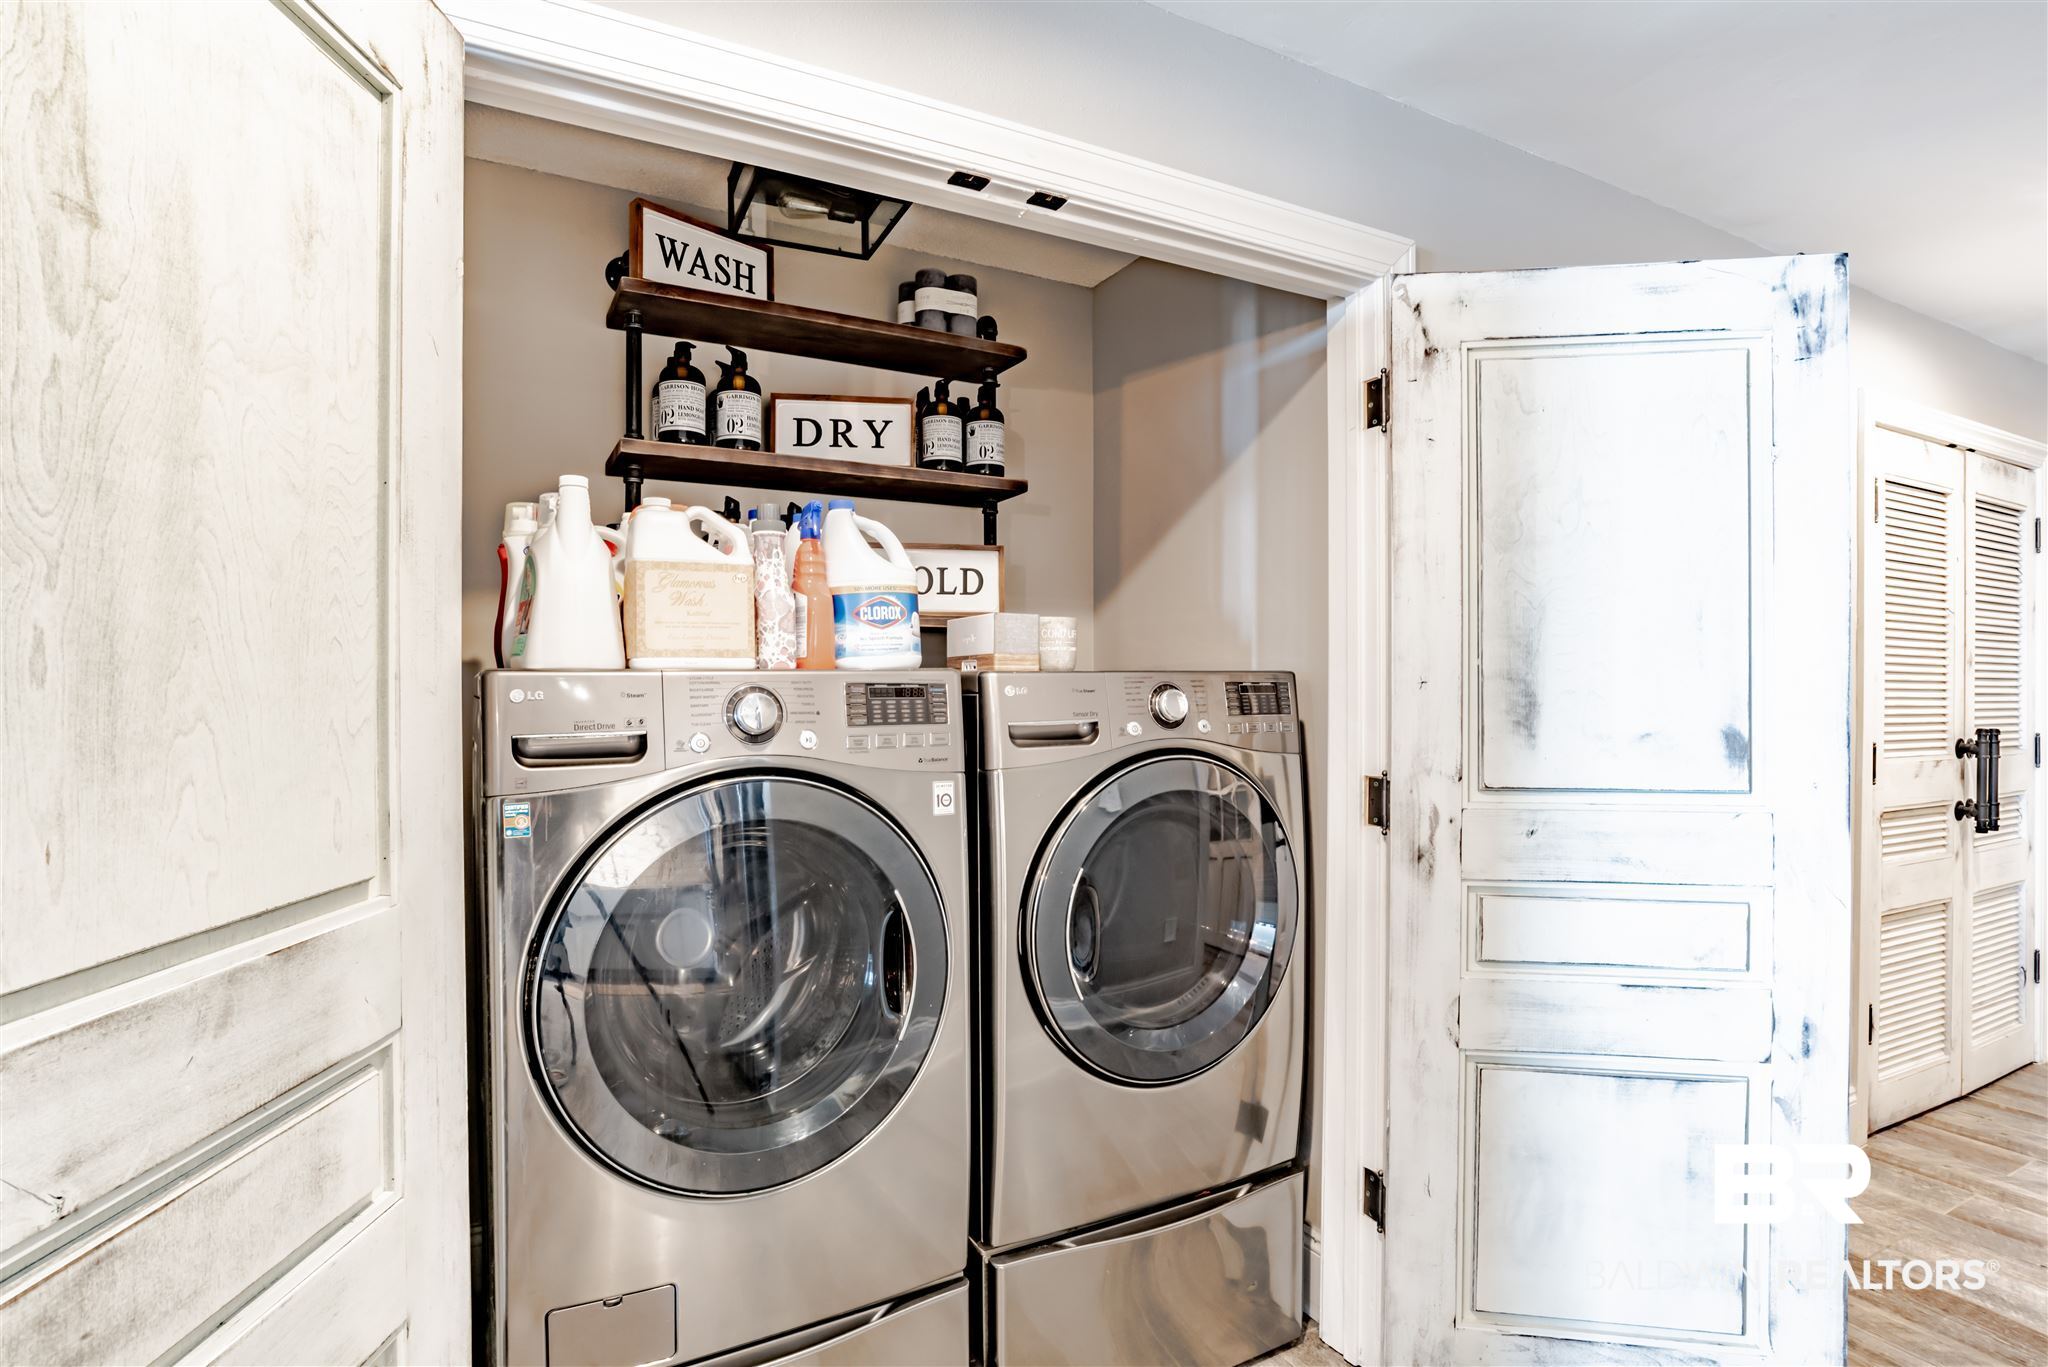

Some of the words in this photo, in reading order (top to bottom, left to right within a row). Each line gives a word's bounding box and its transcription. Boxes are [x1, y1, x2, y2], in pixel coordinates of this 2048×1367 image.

[655, 233, 756, 295] WASH
[726, 393, 756, 401] GARRISON
[660, 408, 675, 425] 02
[726, 417, 744, 434] 02
[792, 417, 893, 449] DRY
[979, 445, 994, 459] 02
[651, 571, 717, 593] Glamorous
[915, 565, 984, 595] OLD
[669, 591, 706, 607] Wash
[859, 606, 902, 620] CLOROX
[527, 690, 544, 700] LG
[1089, 710, 1099, 718] Dry
[573, 722, 597, 731] Direct
[597, 721, 616, 730] Drive
